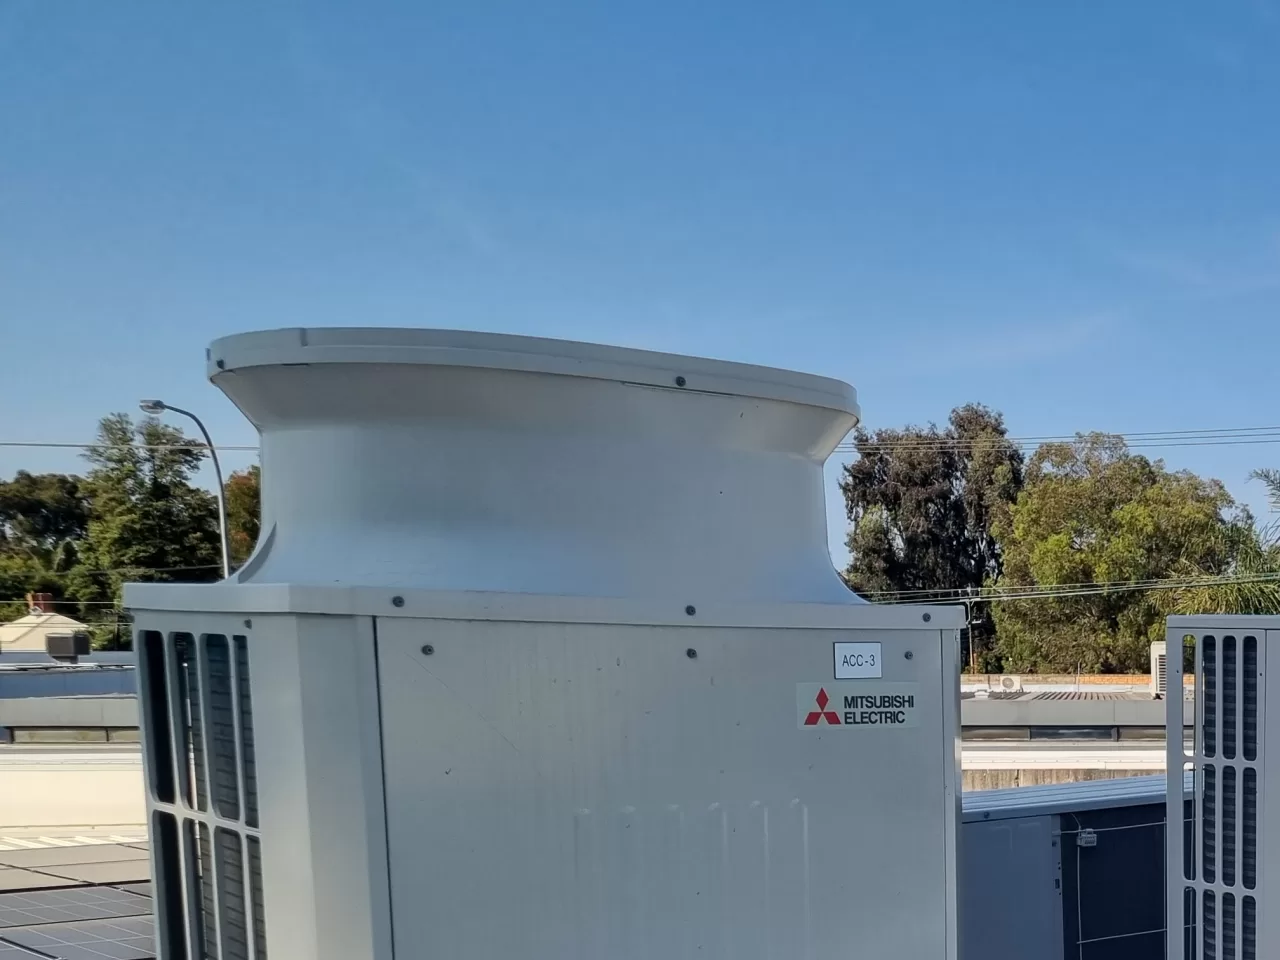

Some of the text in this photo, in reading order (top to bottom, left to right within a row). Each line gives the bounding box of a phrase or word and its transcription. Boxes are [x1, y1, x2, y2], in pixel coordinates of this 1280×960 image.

[842, 654, 876, 667] ACC-3
[843, 695, 915, 709] MITSUBISHI
[843, 711, 906, 725] ELECTRIC
